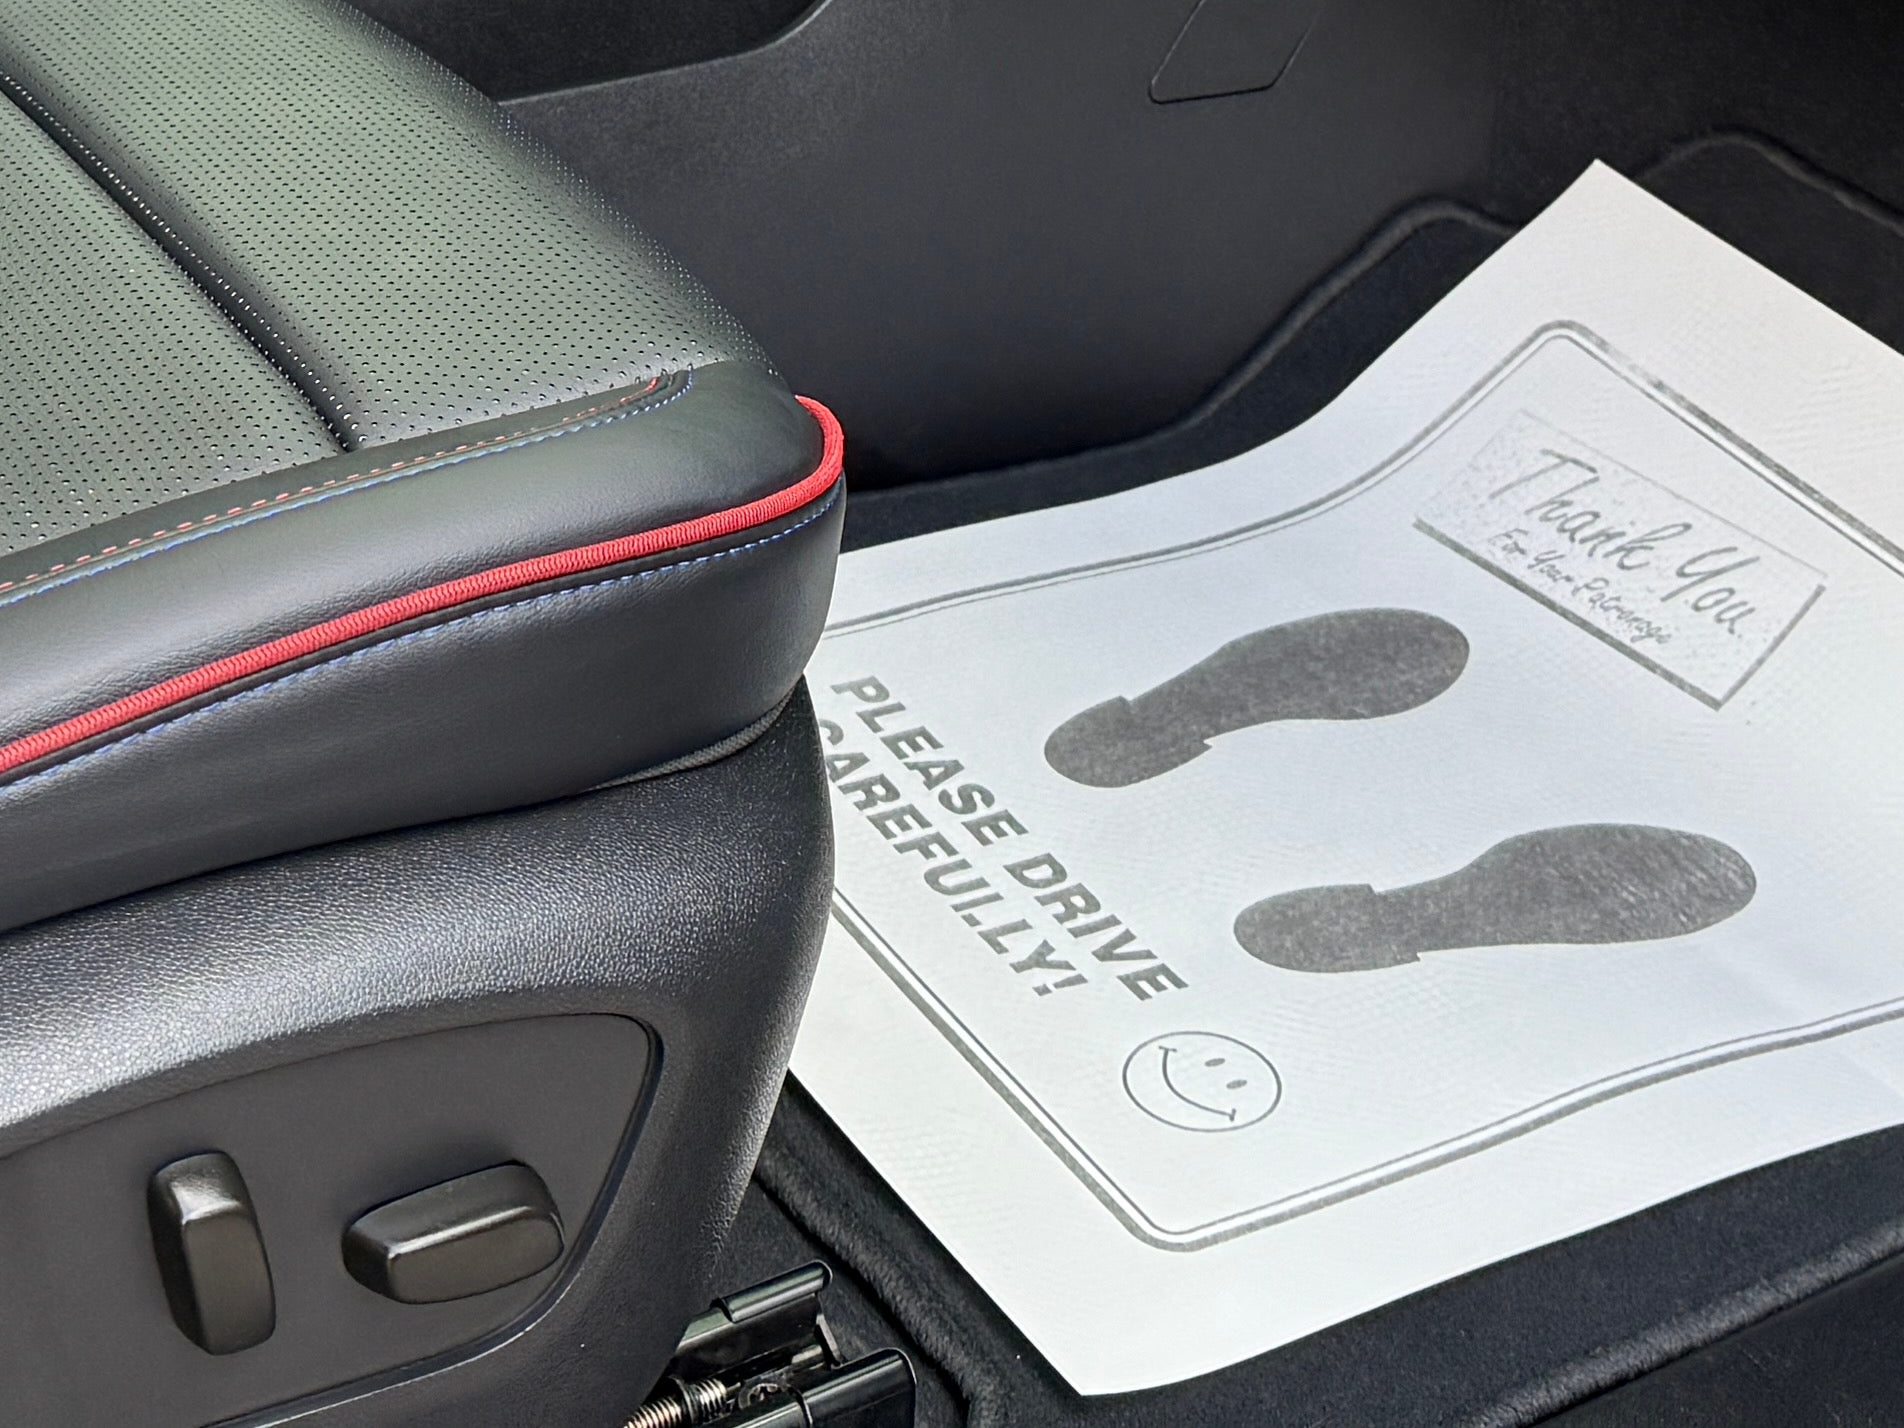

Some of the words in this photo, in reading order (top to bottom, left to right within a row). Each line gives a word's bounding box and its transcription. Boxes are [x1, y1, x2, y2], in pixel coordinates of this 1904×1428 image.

[1489, 447, 1693, 571] Thank
[1661, 546, 1761, 635] You
[1571, 577, 1674, 645] Patronage
[830, 675, 1029, 847] PLEASE
[1002, 852, 1190, 1002] DRIVE
